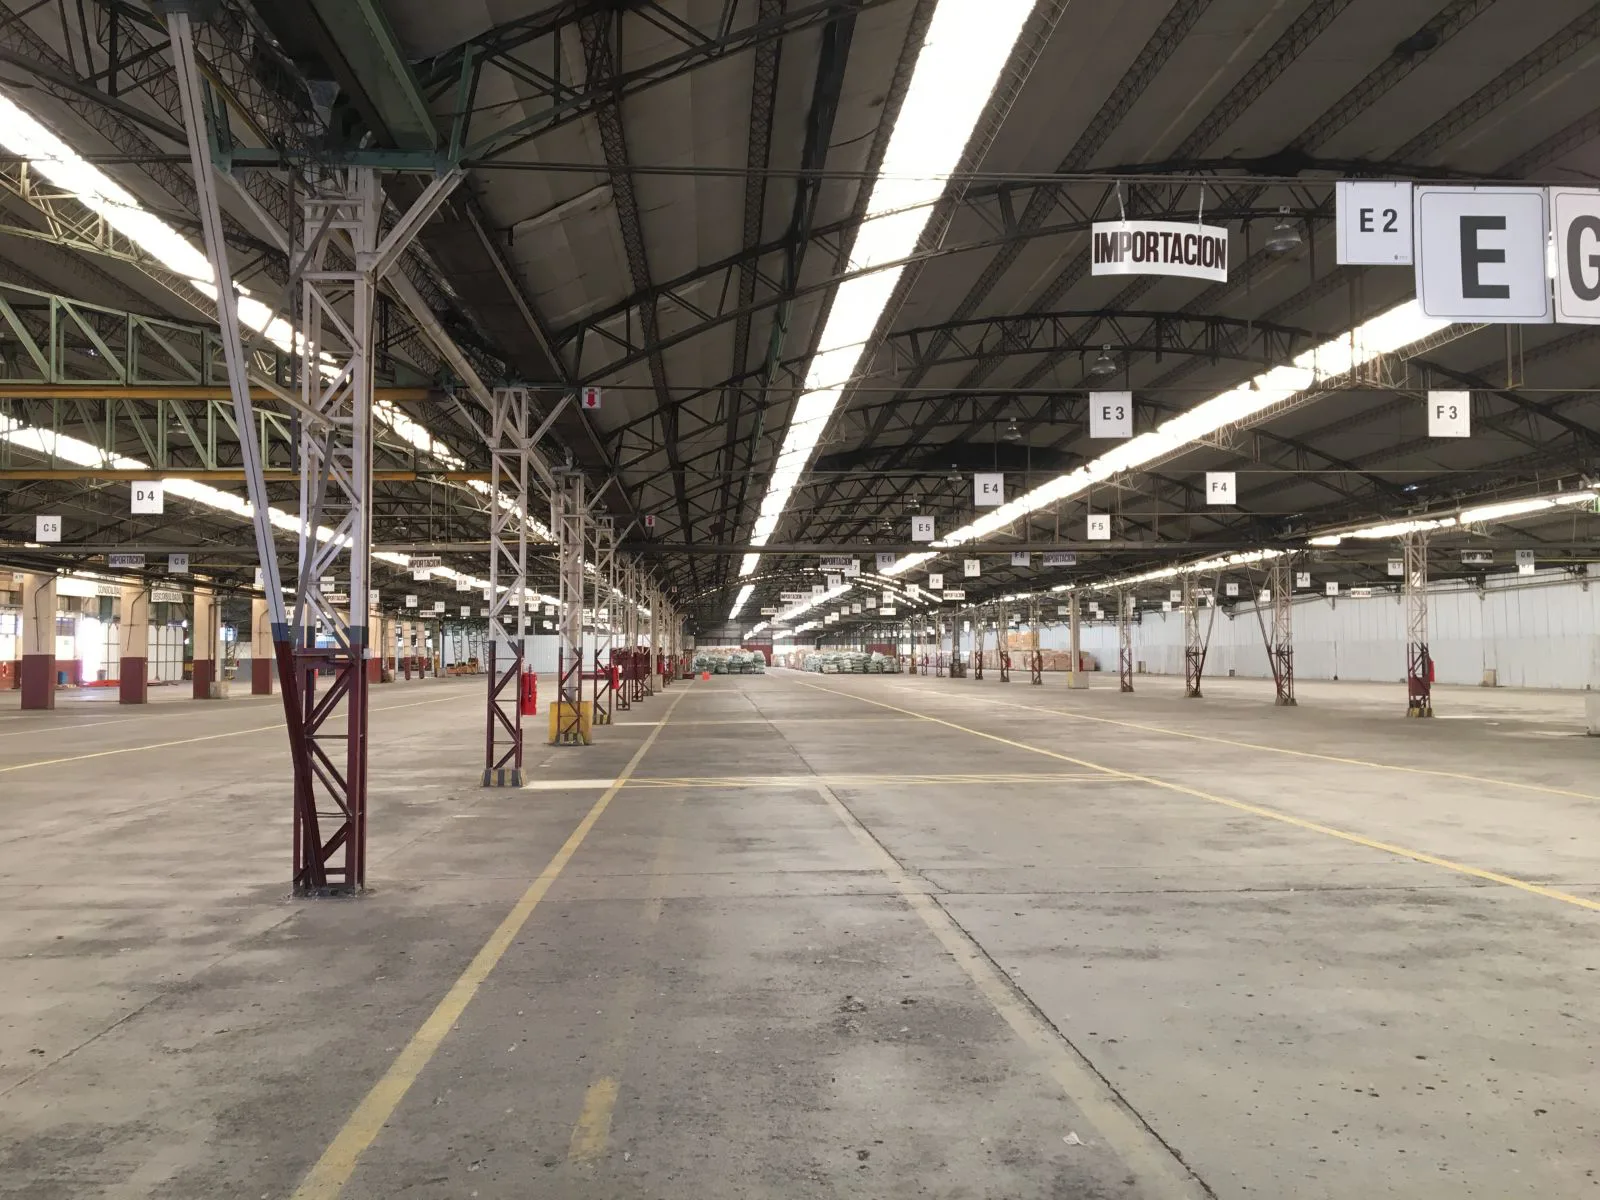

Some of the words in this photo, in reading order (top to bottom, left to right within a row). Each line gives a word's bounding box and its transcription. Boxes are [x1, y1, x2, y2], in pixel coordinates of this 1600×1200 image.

[1094, 231, 1227, 270] IMPORTACION
[1460, 215, 1510, 299] E
[1566, 215, 1600, 301] G
